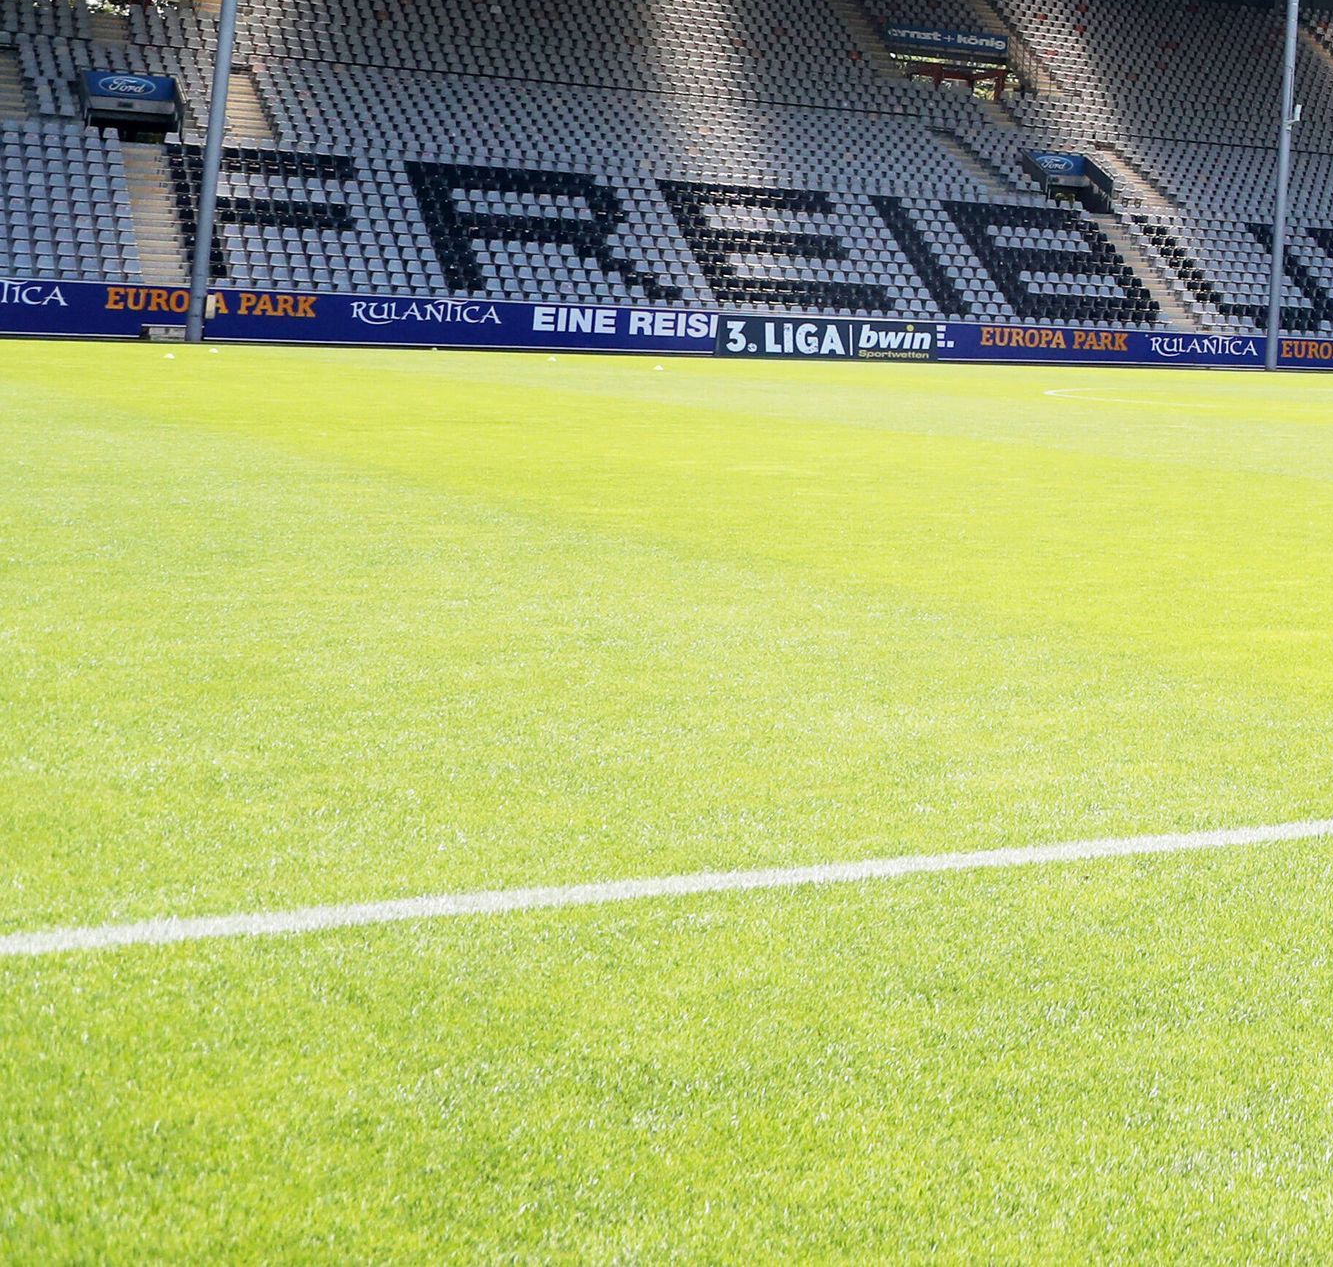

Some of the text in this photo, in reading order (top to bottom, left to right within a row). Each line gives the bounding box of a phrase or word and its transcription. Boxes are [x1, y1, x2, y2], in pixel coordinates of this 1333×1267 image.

[957, 34, 1006, 50] könig
[108, 77, 145, 93] Ford
[1041, 158, 1067, 171] Ford
[105, 286, 318, 317] EUROA PARK
[350, 300, 502, 325] RULANTICA
[532, 307, 617, 334] EINE
[726, 321, 846, 355] 3. LIGA
[858, 323, 932, 350] bwin
[980, 327, 1066, 349] EUROPA
[1072, 331, 1128, 352] PARK
[1150, 335, 1258, 358] RULANTICA
[858, 349, 929, 360] Sportwetten
